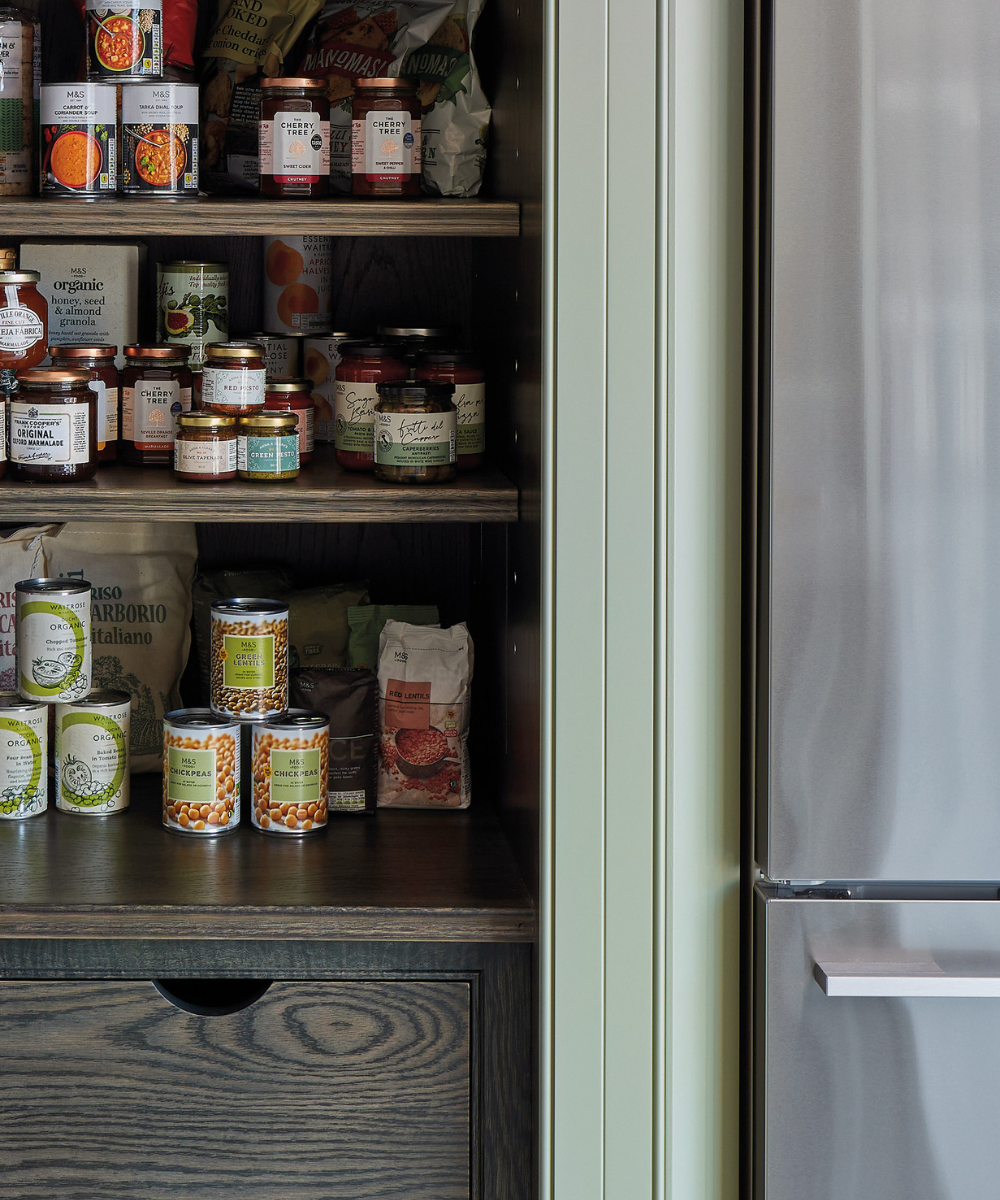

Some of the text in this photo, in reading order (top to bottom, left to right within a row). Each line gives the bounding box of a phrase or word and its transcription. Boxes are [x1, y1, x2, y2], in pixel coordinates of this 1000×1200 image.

[54, 278, 104, 294] organic
[51, 296, 105, 307] honey, seed
[55, 306, 101, 316] & almond
[60, 317, 96, 327] granola
[17, 429, 54, 439] ORIGINAL
[50, 602, 85, 611] WAITROSE
[50, 621, 85, 631] ORGANIC
[404, 692, 430, 700] LENTILS
[94, 712, 127, 721] WAITROSE
[8, 717, 42, 727] WAITROSE
[93, 730, 127, 741] ORGANIC
[7, 737, 42, 747] ORGANIC
[170, 768, 212, 777] CHICKPEAS
[274, 769, 318, 777] CHICKPEAS
